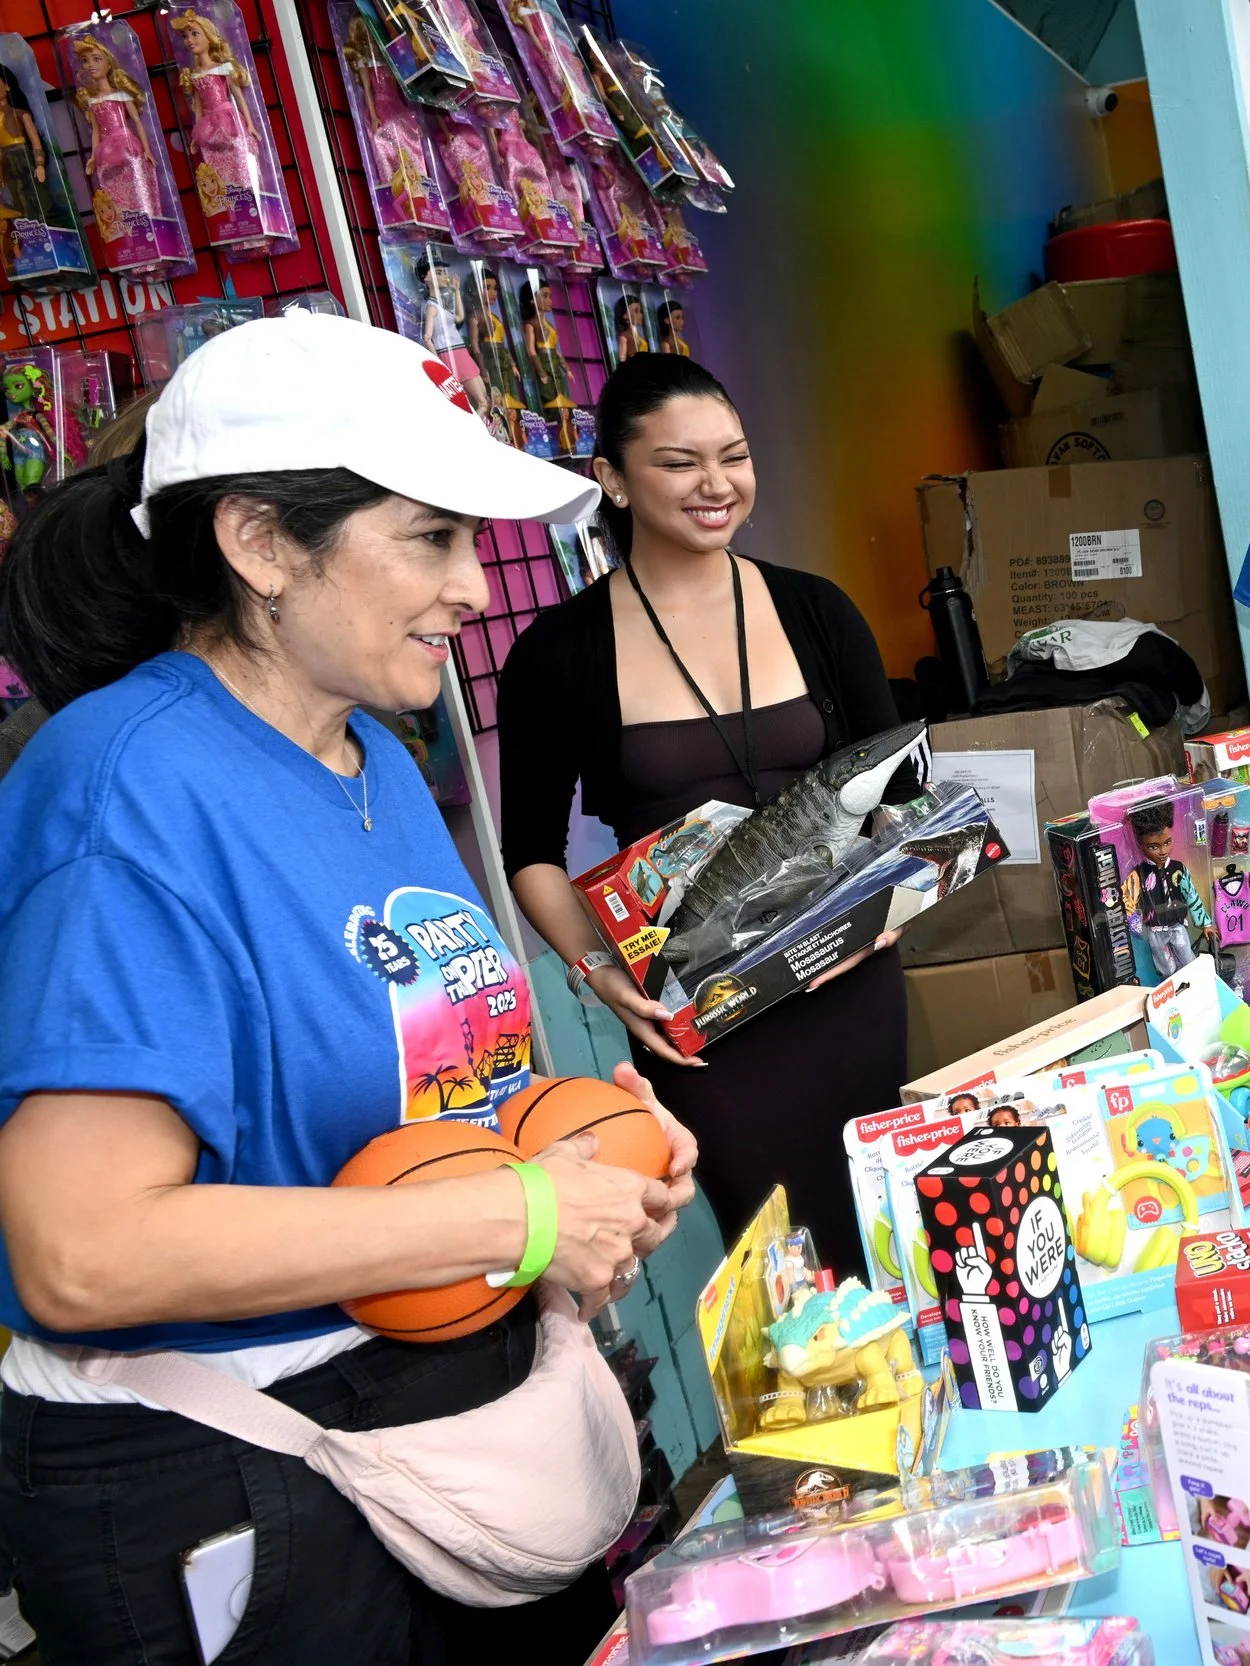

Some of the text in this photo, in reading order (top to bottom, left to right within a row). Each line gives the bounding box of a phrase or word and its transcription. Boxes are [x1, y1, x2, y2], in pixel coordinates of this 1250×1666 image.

[1071, 535, 1101, 547] 1200BRN
[1011, 579, 1085, 592] Color: BROWN
[1012, 590, 1098, 604] Quantity: 100 pcs
[1094, 846, 1117, 888] HIGH
[368, 933, 399, 961] 25
[405, 909, 490, 960] PARTY
[623, 930, 658, 952] TRY ME!
[1106, 905, 1134, 979] MONSTER
[628, 938, 662, 960] ESSAIE!
[784, 947, 798, 959] BITE
[787, 946, 814, 964] ATTAQUE
[812, 941, 820, 949] ET
[790, 937, 844, 973] Mosasaurus
[384, 956, 411, 974] YEARS
[455, 946, 509, 996] PIER
[795, 951, 839, 981] Mosasaur
[486, 989, 516, 1018] 2025
[694, 1004, 728, 1029] JURASSIC
[727, 986, 757, 1008] WORLD
[993, 1018, 1077, 1057] fisher-price
[1109, 1091, 1129, 1110] fp
[860, 1112, 922, 1135] fisher-price
[896, 1124, 960, 1148] fisher-price
[1030, 1209, 1043, 1234] IF
[1026, 1222, 1055, 1257] YOU
[1024, 1239, 1064, 1287] WERE
[1184, 1241, 1227, 1278] UNO
[971, 1309, 998, 1404] KNOW YOUR FRIENDS?
[981, 1315, 1004, 1398] HOW WELL DO YOU
[1168, 1392, 1185, 1405] the
[1186, 1384, 1199, 1395] all
[1202, 1387, 1235, 1403] about
